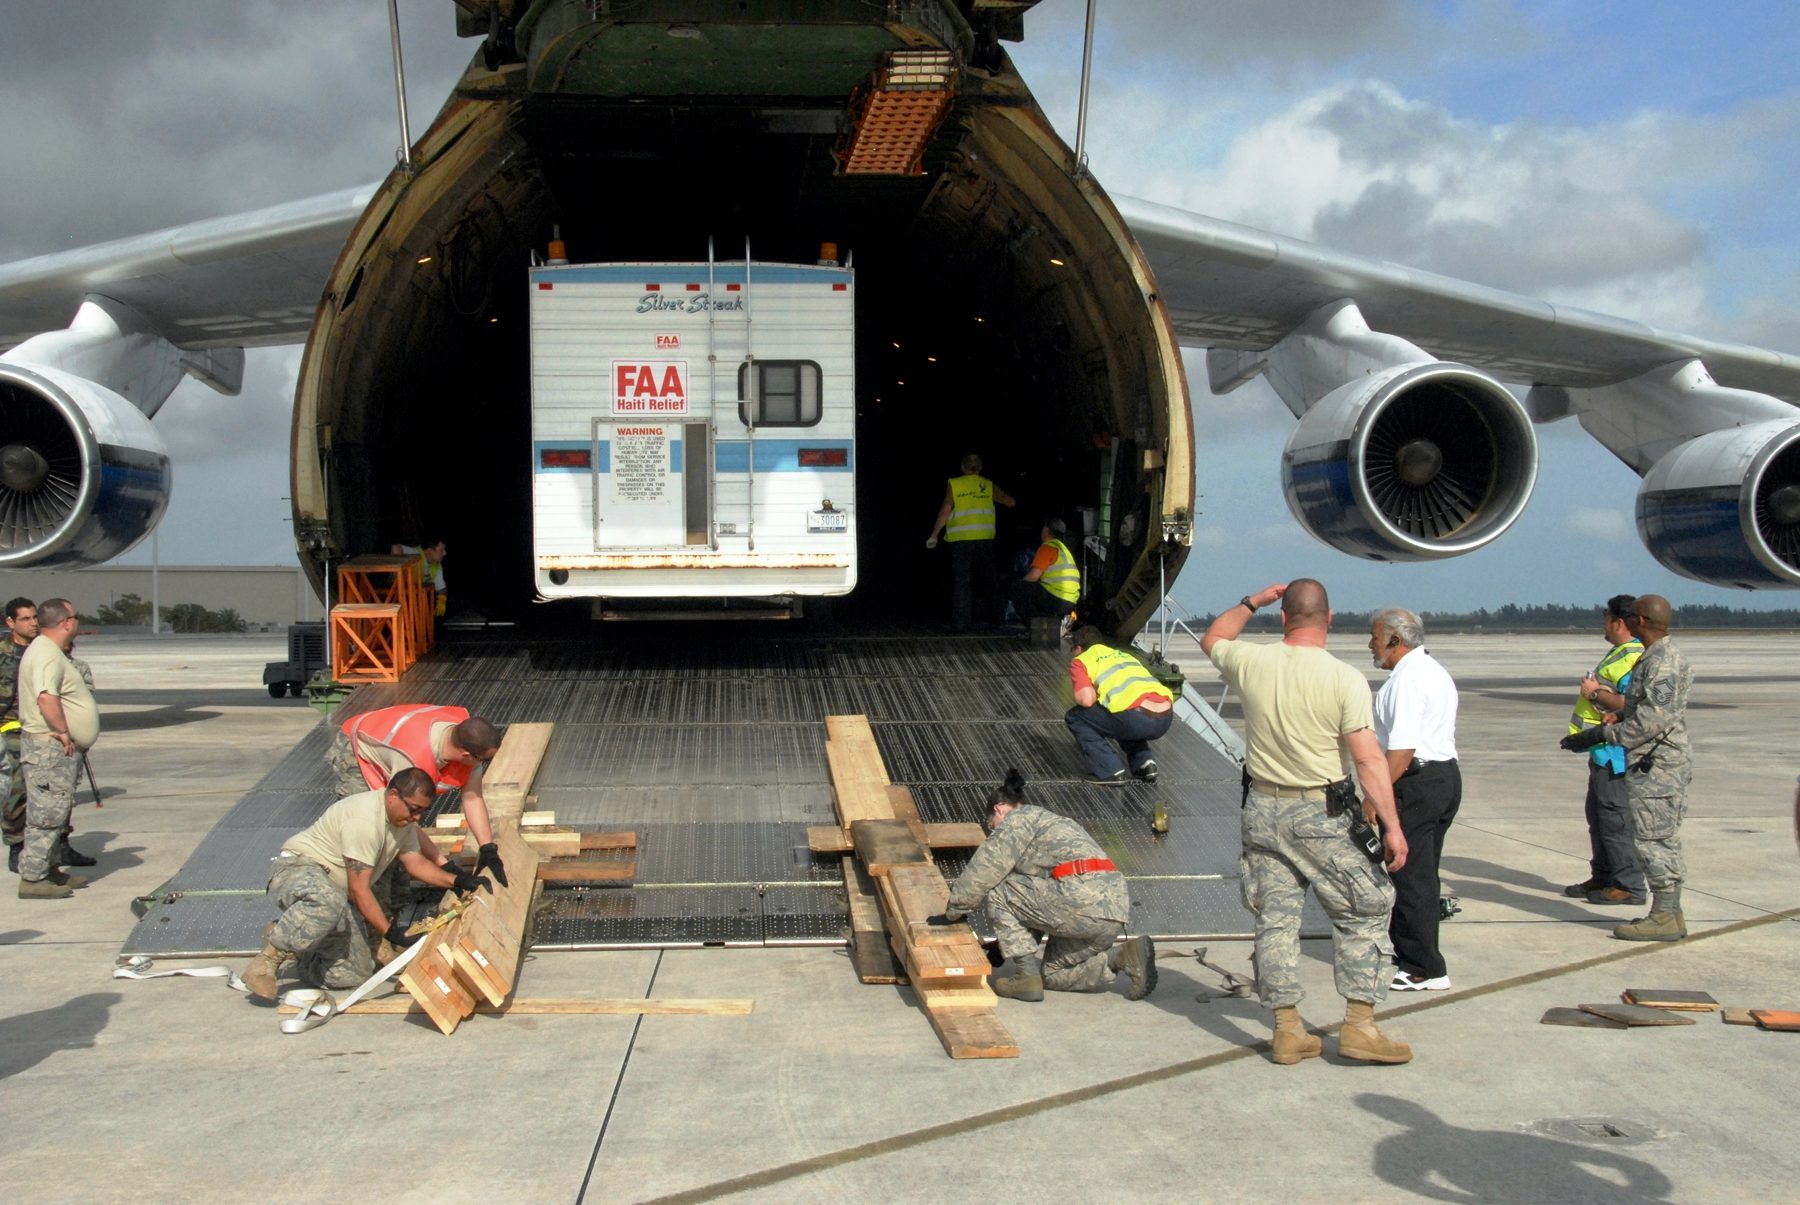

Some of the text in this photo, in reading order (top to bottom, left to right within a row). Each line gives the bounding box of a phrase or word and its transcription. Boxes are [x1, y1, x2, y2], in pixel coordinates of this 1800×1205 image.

[636, 293, 744, 313] Silver Streak
[656, 336, 679, 345] FAA
[617, 365, 685, 397] FAA
[617, 399, 685, 410] Haiti Relief
[617, 427, 663, 436] WARNING
[821, 515, 845, 526] 30087
